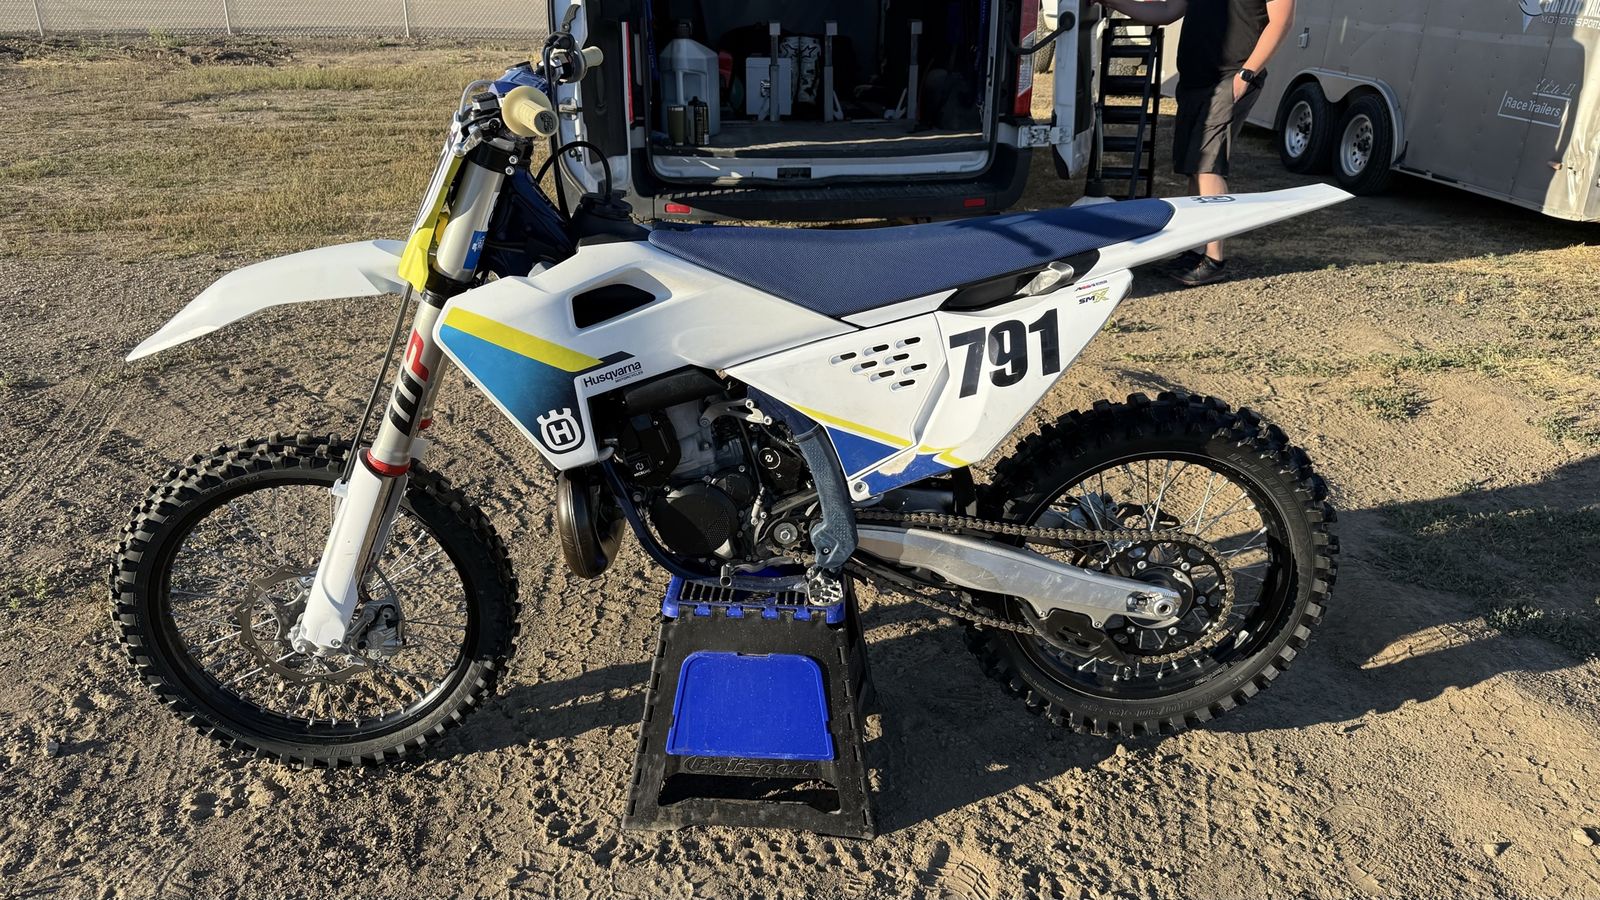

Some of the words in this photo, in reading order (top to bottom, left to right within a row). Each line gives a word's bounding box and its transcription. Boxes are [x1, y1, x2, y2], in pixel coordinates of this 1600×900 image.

[1504, 96, 1528, 111] Race
[1079, 289, 1109, 304] SMX
[949, 308, 1060, 399] 791
[583, 361, 642, 388] Husqvarna
